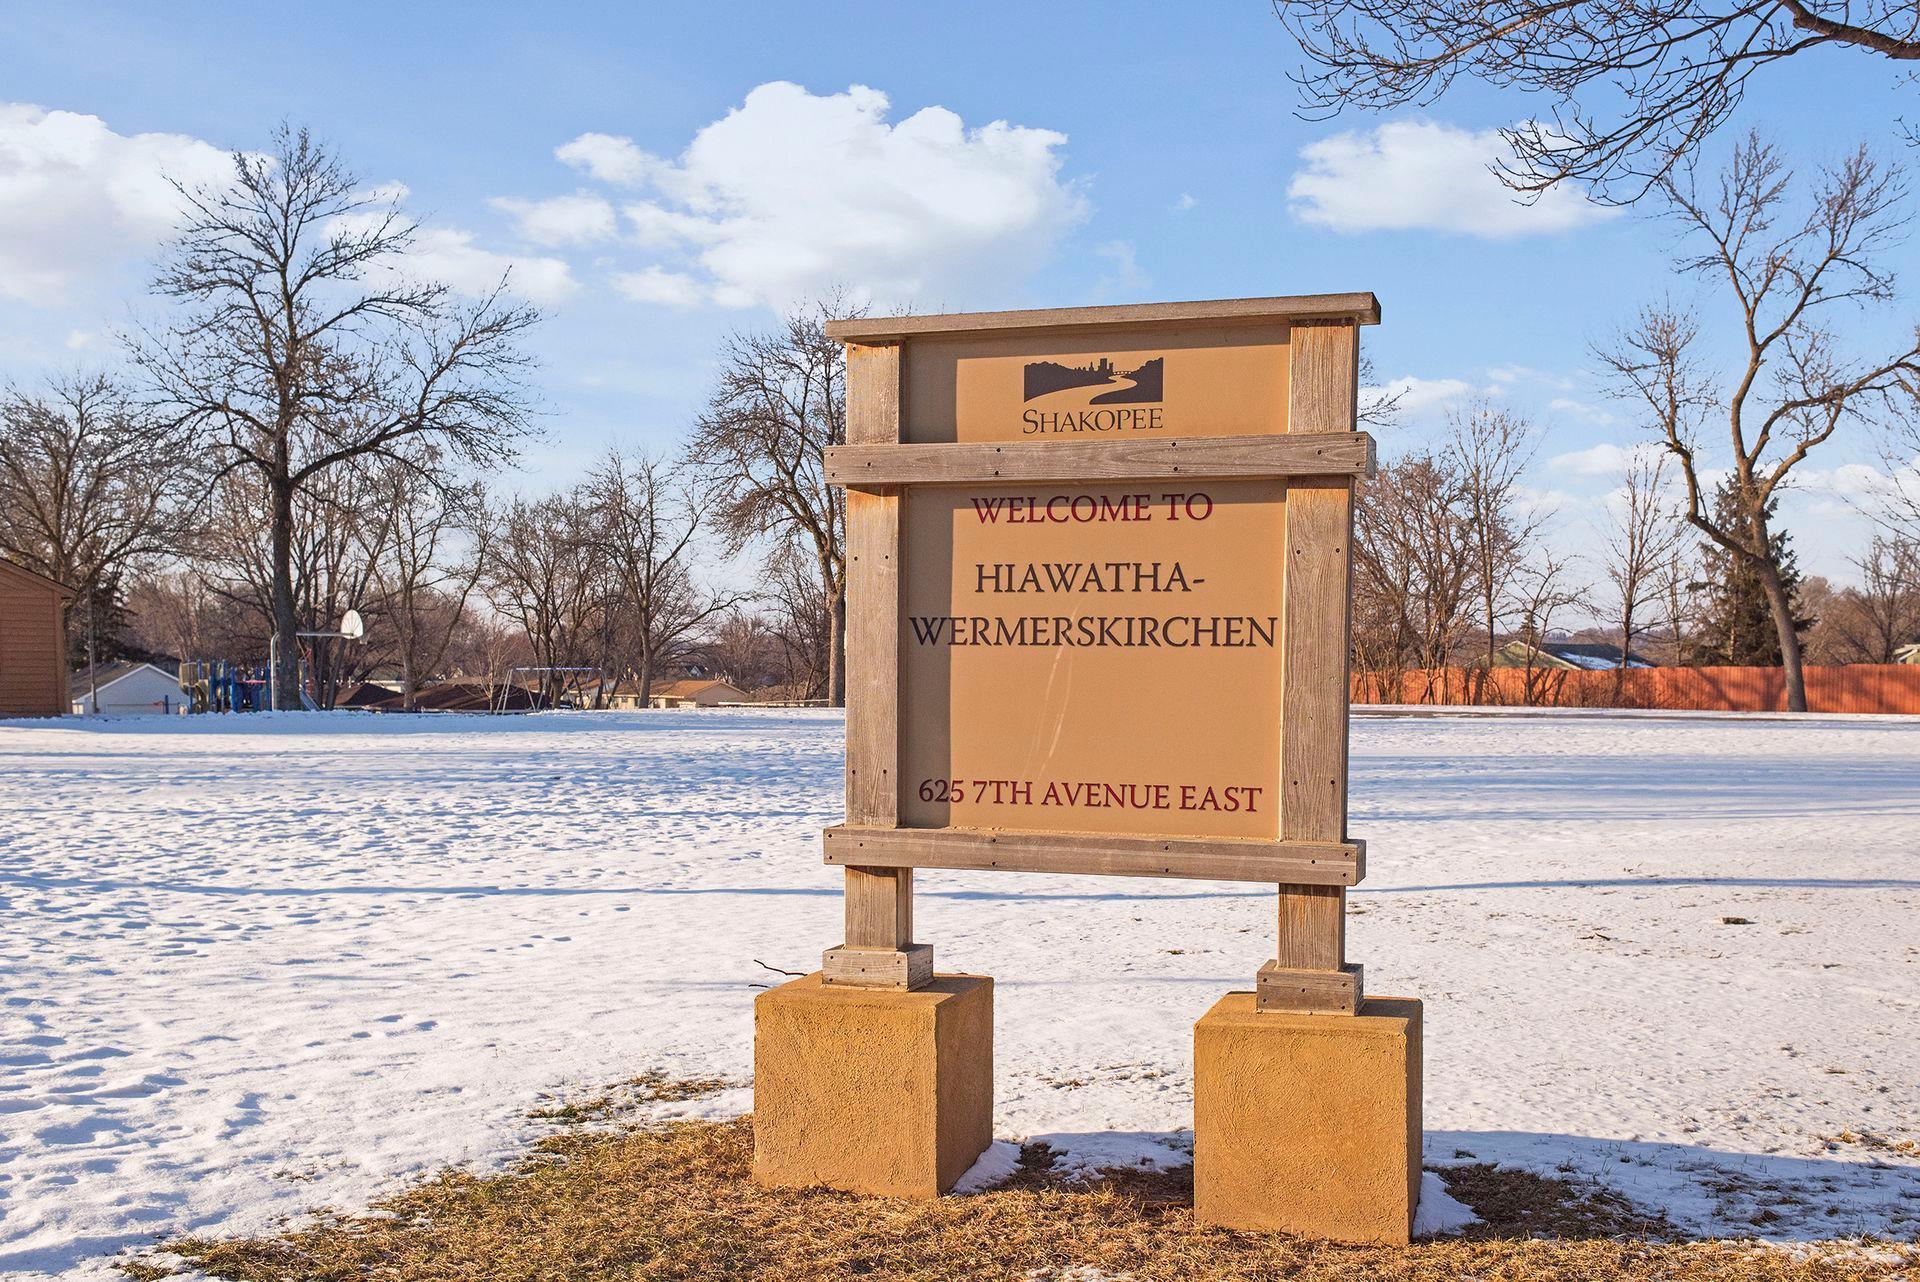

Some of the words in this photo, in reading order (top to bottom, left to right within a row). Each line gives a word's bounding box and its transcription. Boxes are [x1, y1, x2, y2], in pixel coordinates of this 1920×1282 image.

[971, 494, 1153, 525] WELCOME
[1161, 493, 1213, 521] TO
[974, 562, 1206, 593] HIAWATHA-
[908, 616, 1278, 648] WERMERSKIRCHEN
[918, 778, 965, 804] 625
[972, 779, 1033, 806] 7TH
[1041, 781, 1170, 810] AVENUE
[1178, 784, 1263, 813] EAST
